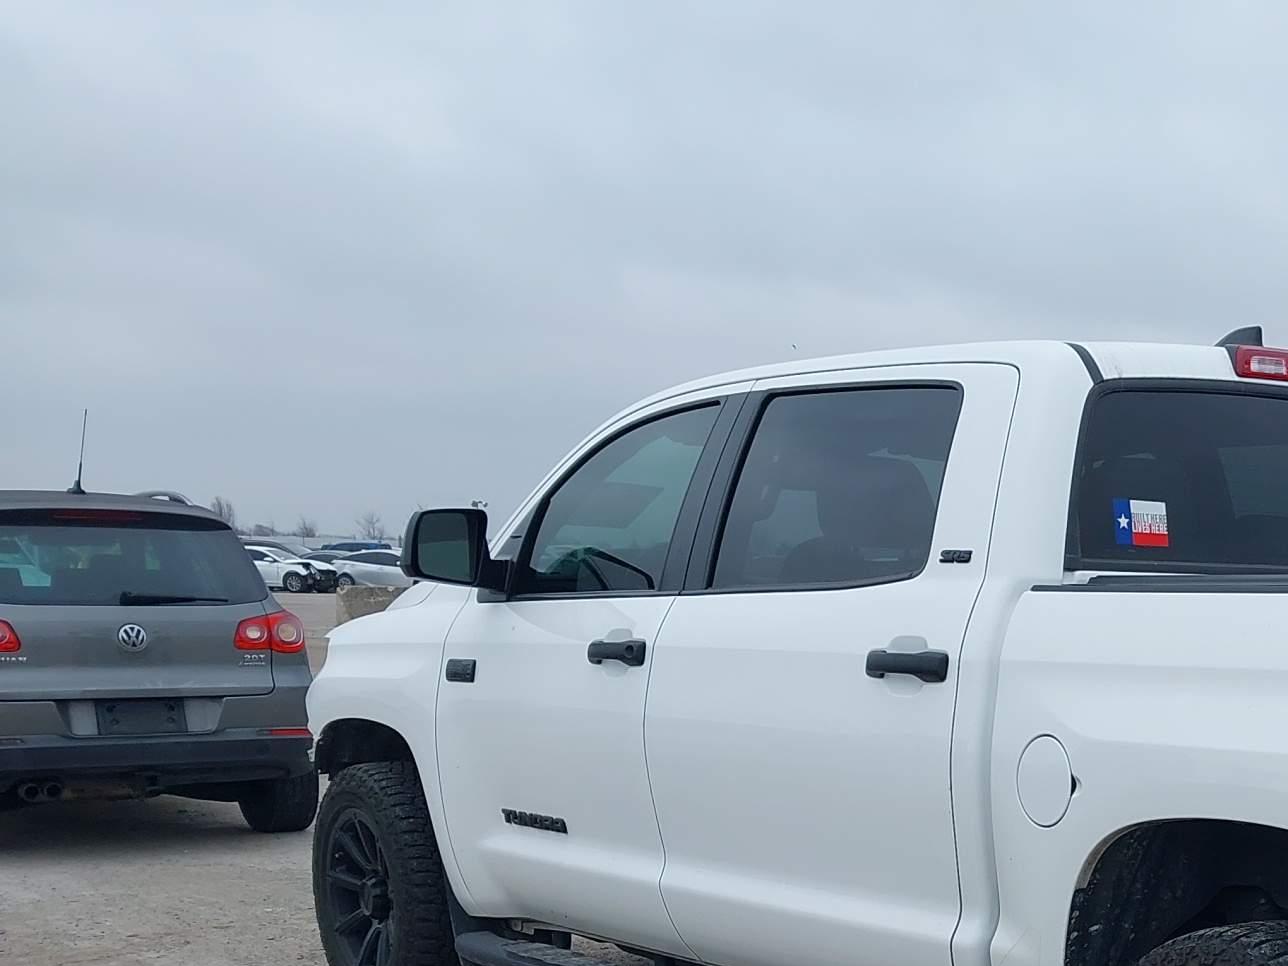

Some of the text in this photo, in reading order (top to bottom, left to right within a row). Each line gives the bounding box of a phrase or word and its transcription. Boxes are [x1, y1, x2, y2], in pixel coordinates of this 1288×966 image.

[1150, 513, 1168, 524] HERE
[1151, 523, 1169, 534] HERE
[501, 808, 569, 834] TUNDRA
